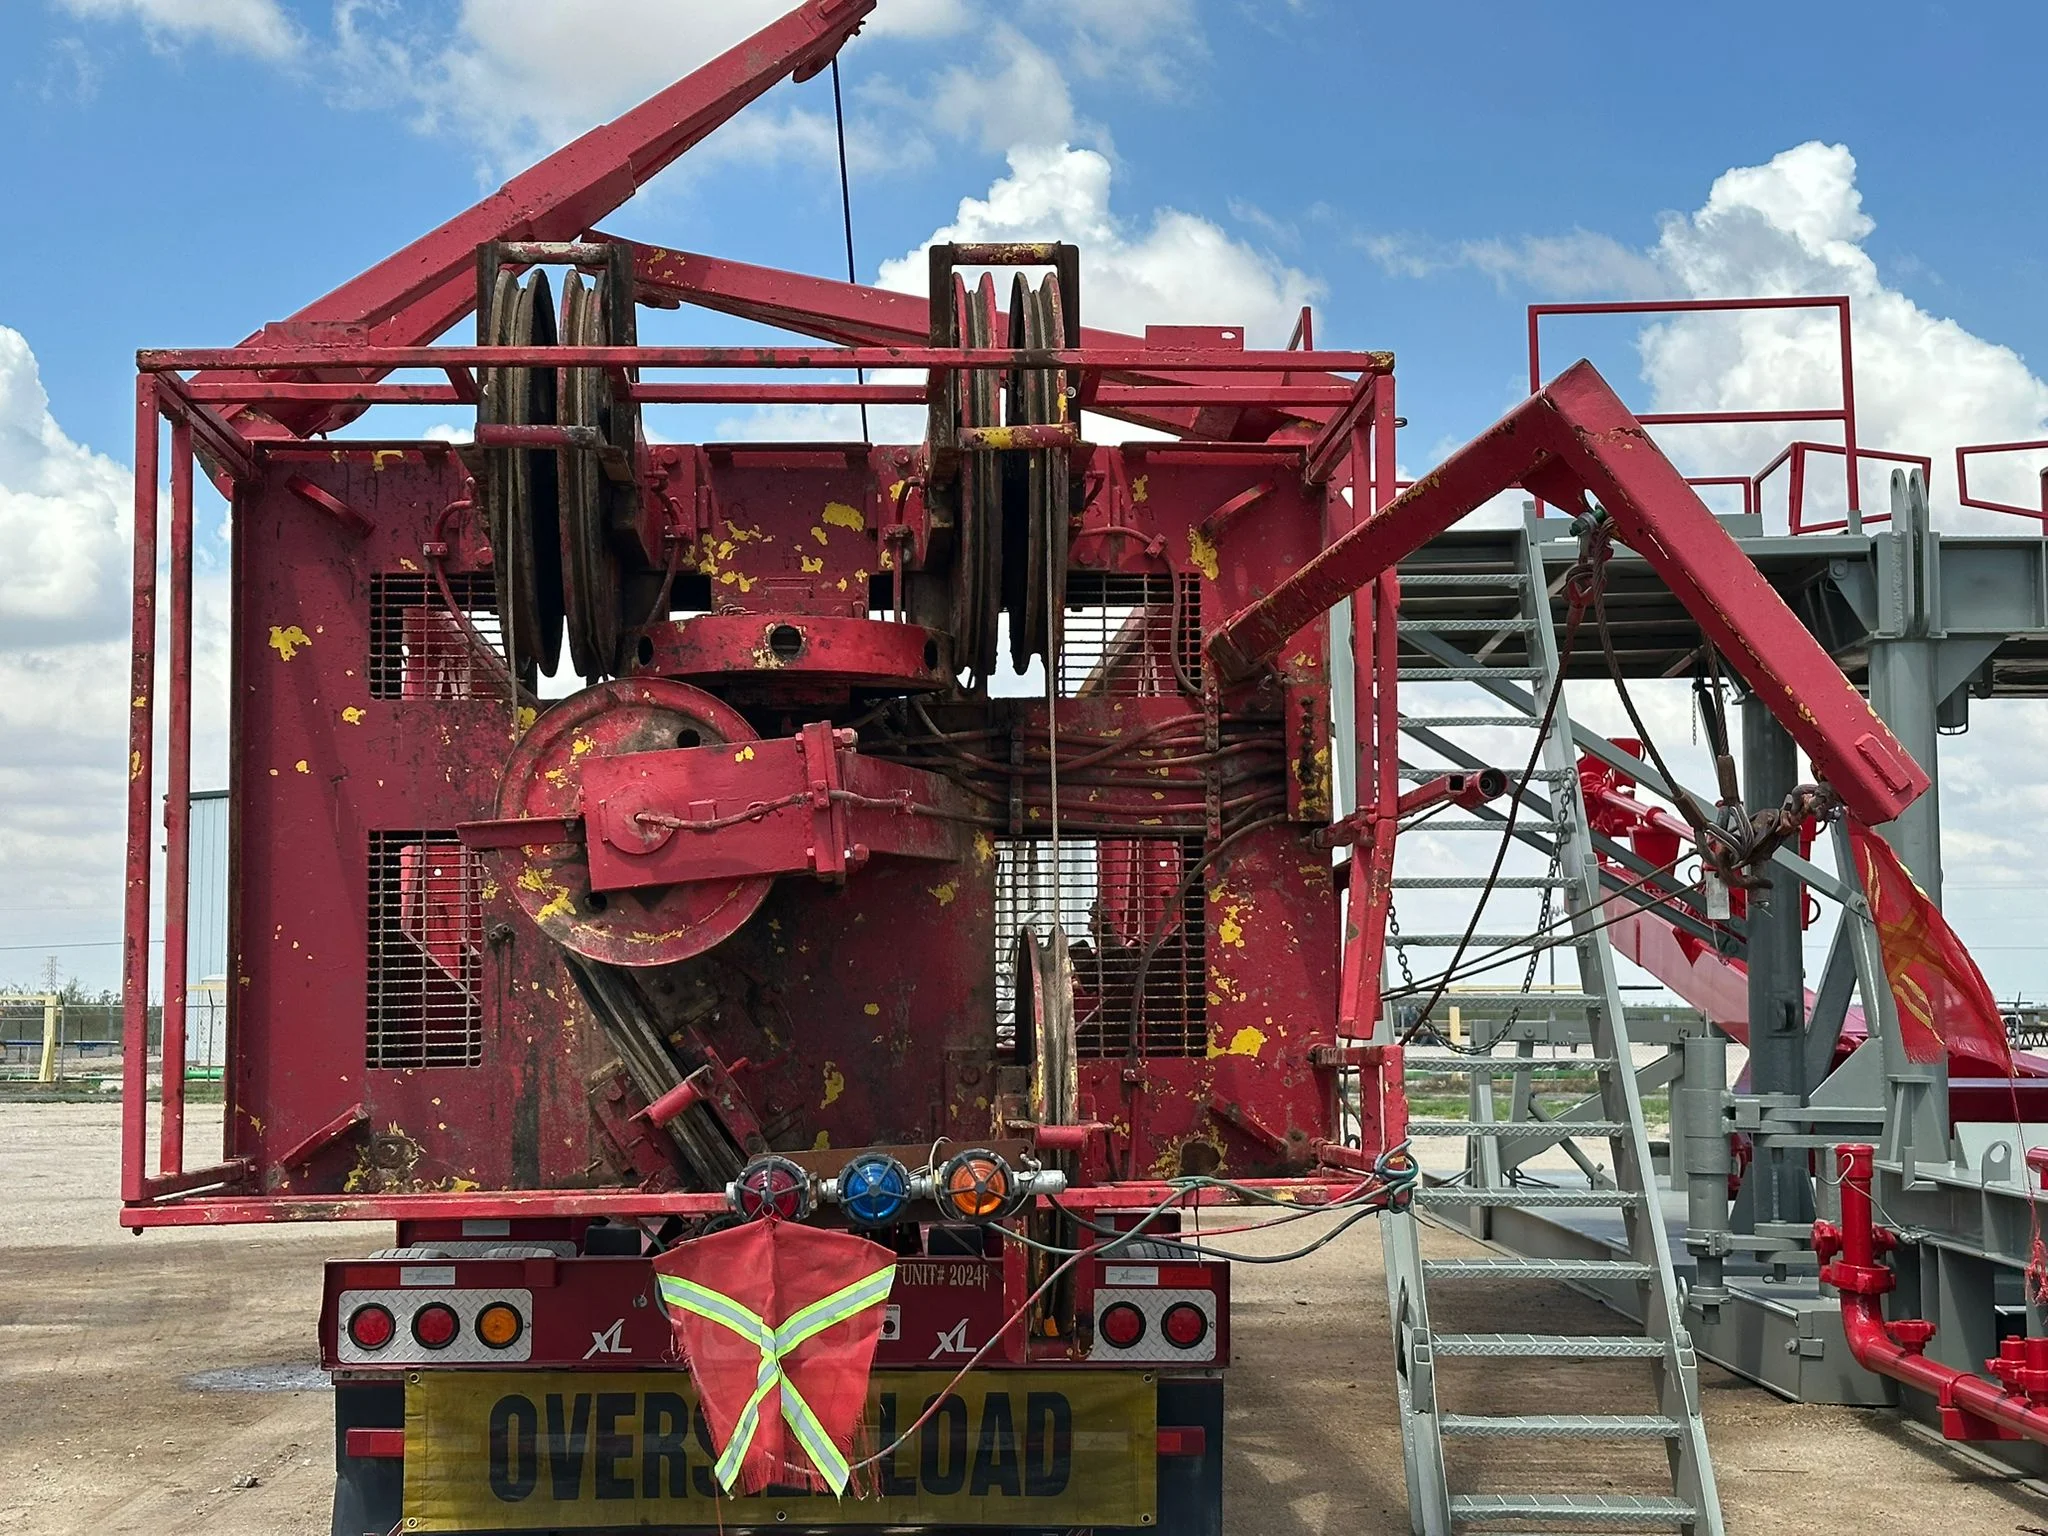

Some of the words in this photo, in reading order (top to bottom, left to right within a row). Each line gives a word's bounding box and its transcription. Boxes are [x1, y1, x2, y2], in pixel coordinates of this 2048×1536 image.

[901, 1263, 945, 1286] UNIT#
[582, 1318, 633, 1360] XL
[928, 1318, 977, 1360] XL
[879, 1391, 1073, 1498] LOAD
